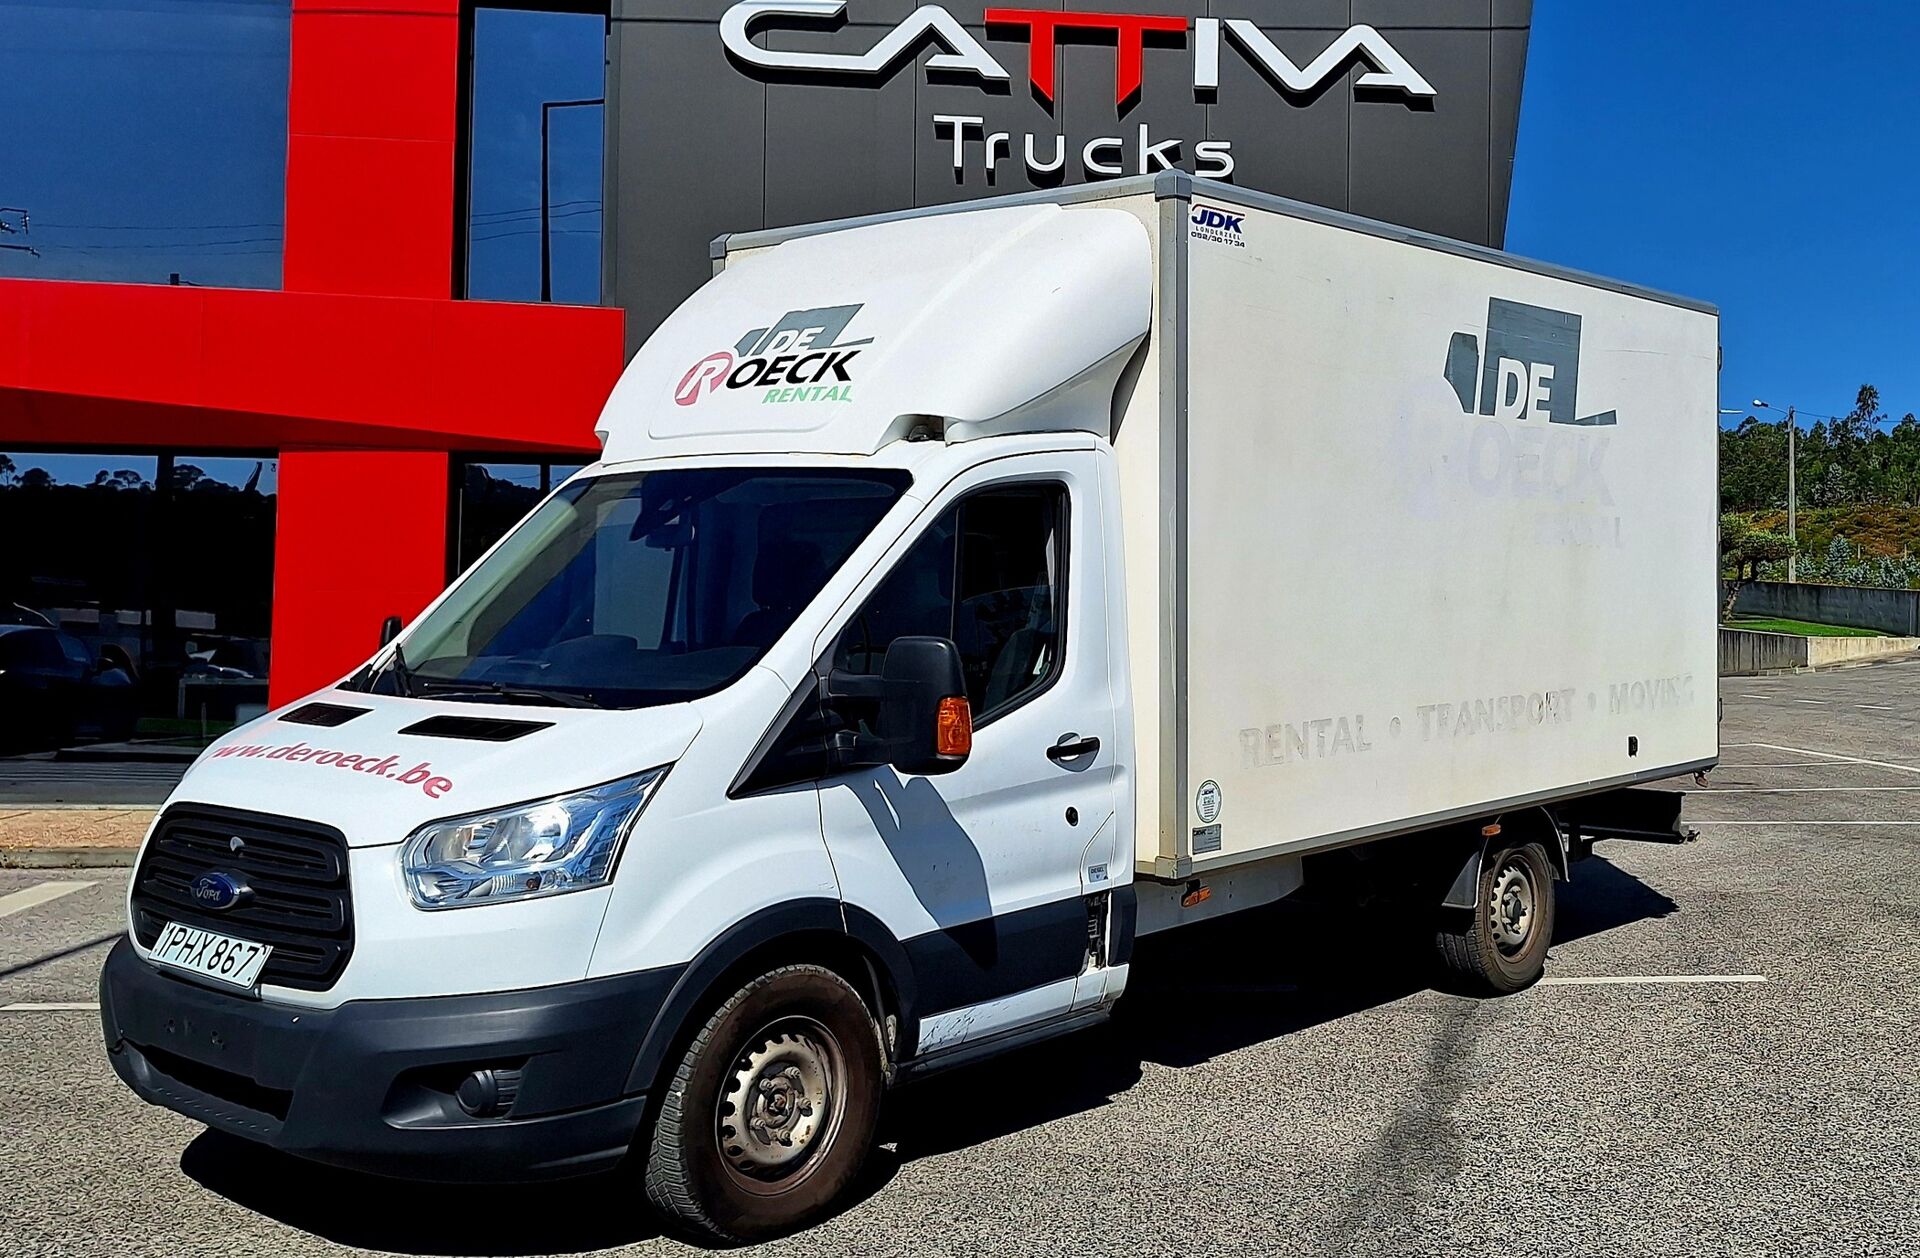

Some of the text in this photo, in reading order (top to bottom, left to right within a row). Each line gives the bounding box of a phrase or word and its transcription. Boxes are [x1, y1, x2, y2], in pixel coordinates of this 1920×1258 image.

[719, 0, 1438, 105] CATTIVA
[933, 114, 1235, 178] Trucks
[1191, 209, 1245, 234] JDK
[771, 326, 827, 353] DE
[675, 350, 862, 406] ROECK
[762, 385, 853, 404] RENTAL
[1494, 356, 1555, 421] DE
[1239, 713, 1373, 770] RENTAL
[1416, 687, 1575, 741] TRANSPORT
[212, 742, 453, 799] ww.deroeck.be
[196, 878, 221, 901] Ford
